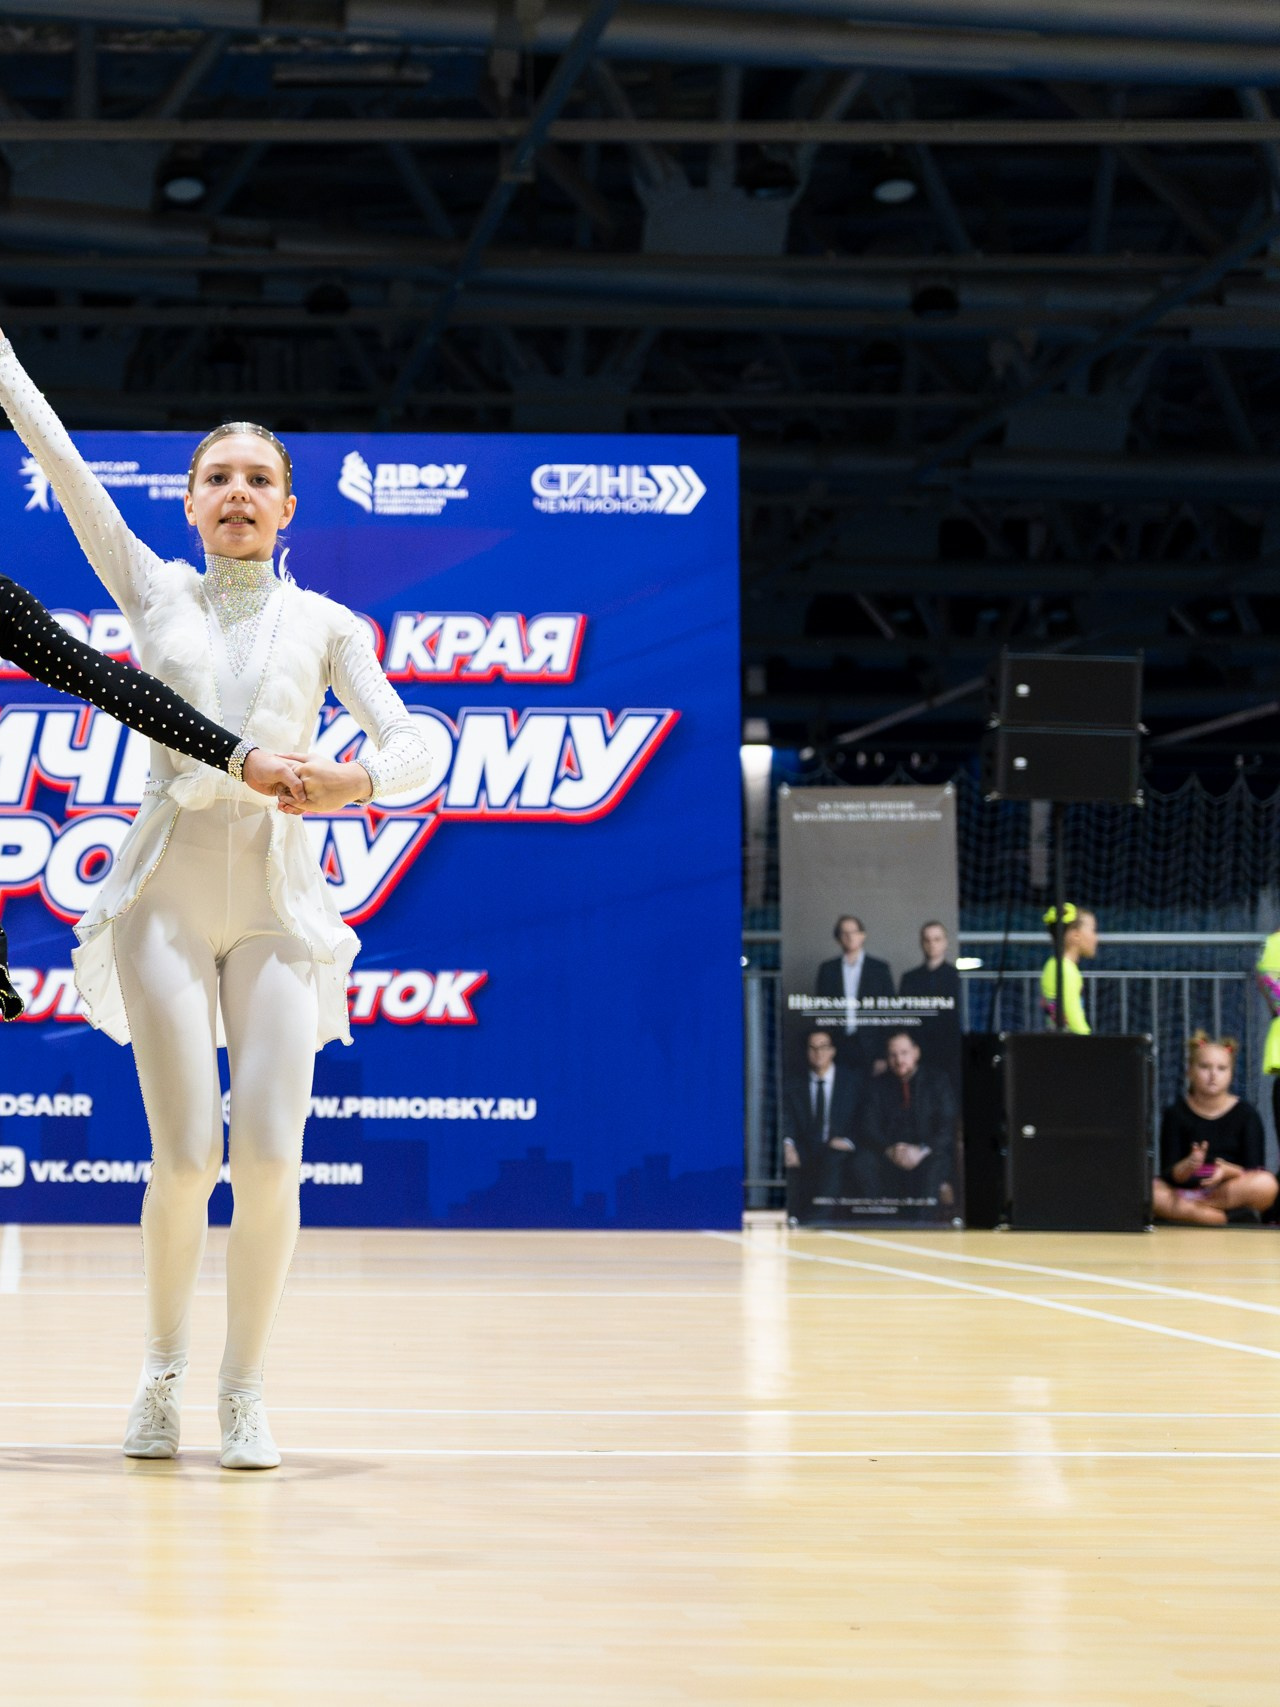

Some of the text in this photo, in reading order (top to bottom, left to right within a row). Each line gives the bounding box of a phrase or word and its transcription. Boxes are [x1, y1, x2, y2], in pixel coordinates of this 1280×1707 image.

[373, 463, 467, 489] ДВФУ
[530, 463, 659, 499] СТАНЬ
[532, 497, 664, 514] ЧЕМПИОНОМ
[386, 612, 586, 680] КРАЯ
